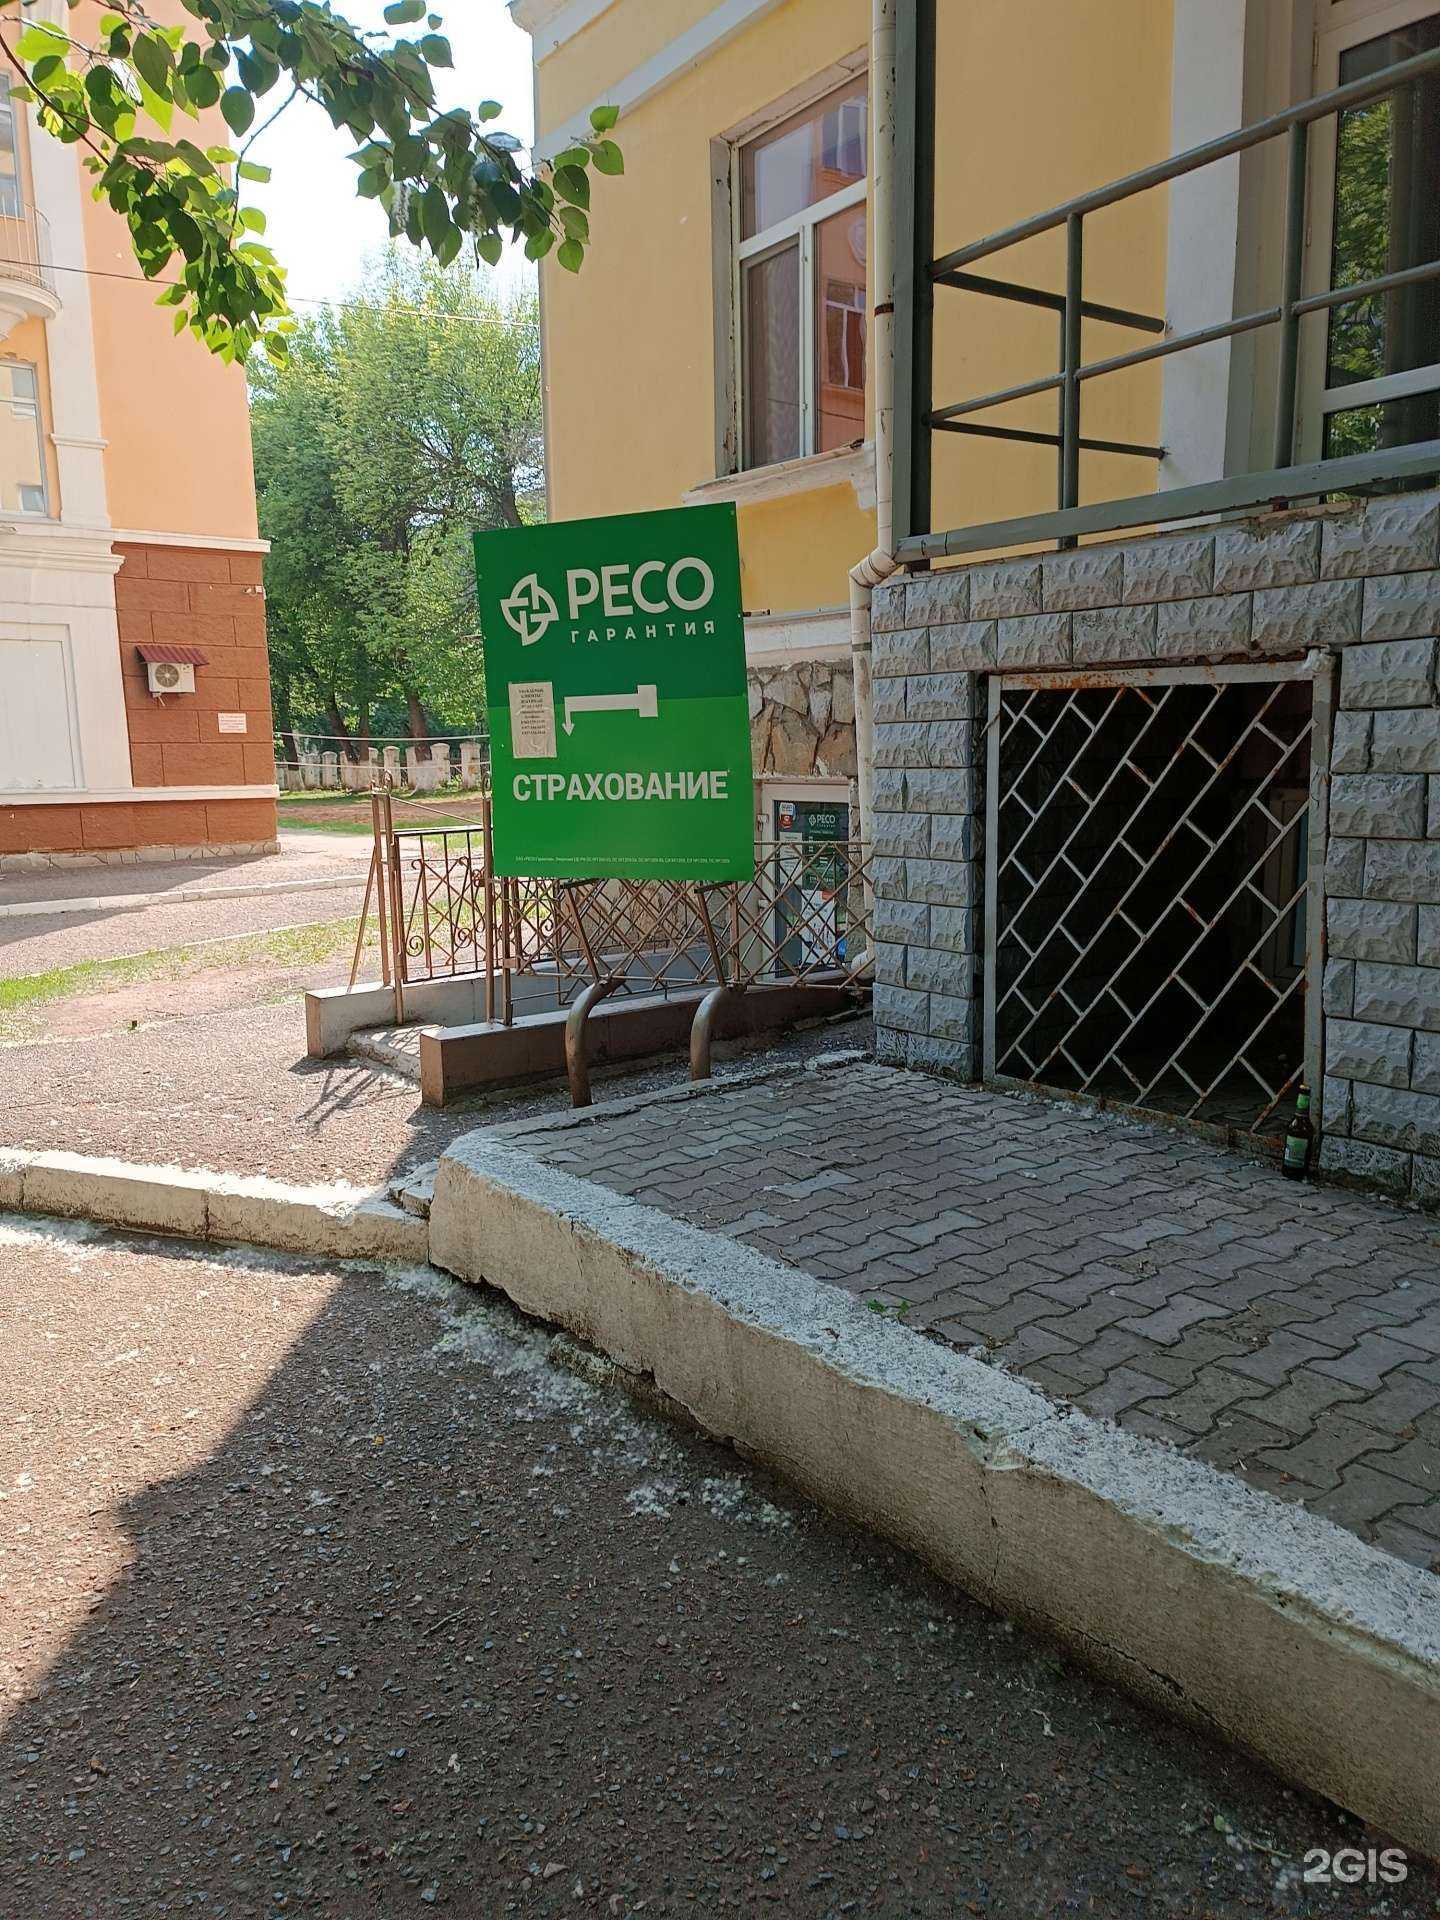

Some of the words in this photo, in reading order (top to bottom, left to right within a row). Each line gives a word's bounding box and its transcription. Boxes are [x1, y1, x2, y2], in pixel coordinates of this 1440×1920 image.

[566, 557, 715, 620] РЕСО
[570, 620, 715, 643] ГАРАНТИЯ
[512, 770, 729, 801] СТРАХОВАНИЕ
